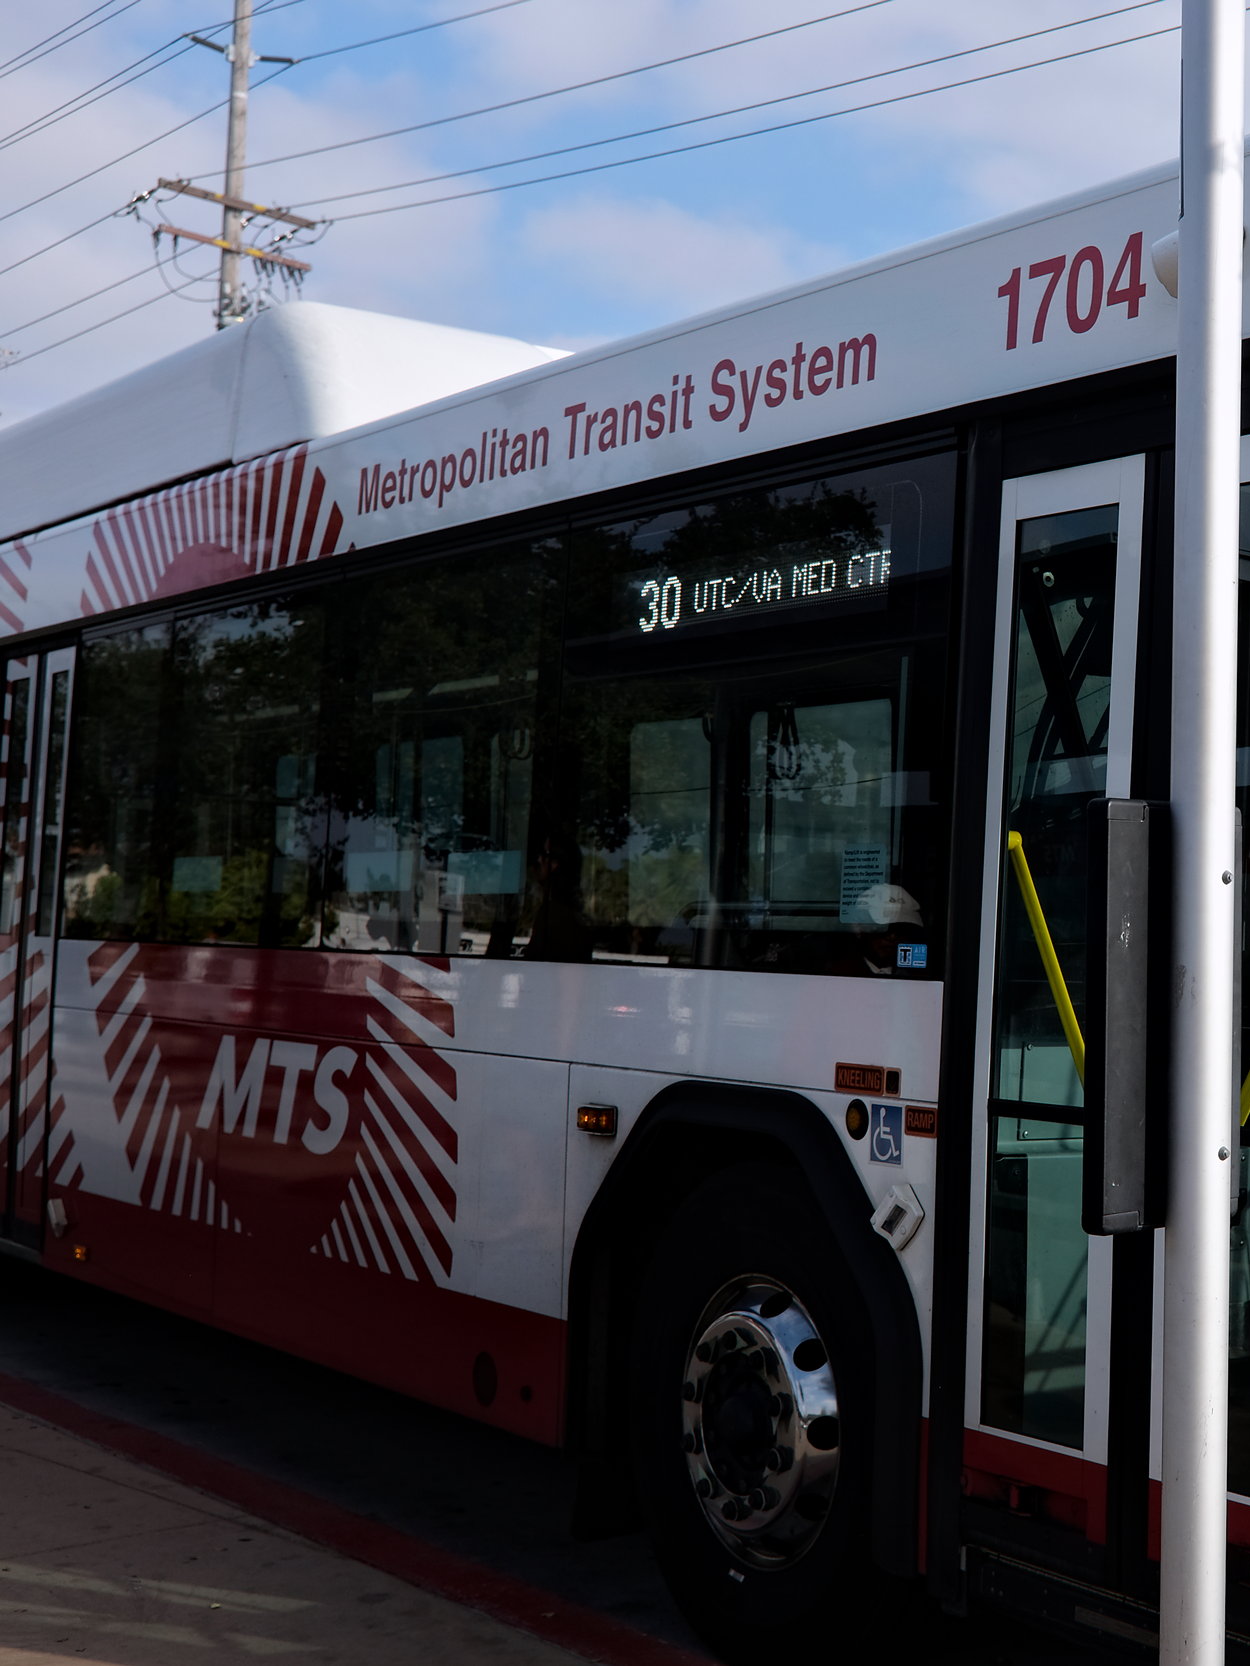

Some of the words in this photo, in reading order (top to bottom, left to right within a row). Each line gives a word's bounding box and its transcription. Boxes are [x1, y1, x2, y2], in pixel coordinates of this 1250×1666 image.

[998, 231, 1147, 351] 1704
[357, 426, 550, 516] Metropolitan
[564, 374, 696, 460] Transit
[708, 332, 878, 433] System
[639, 575, 682, 632] 30
[694, 569, 782, 613] UTC/VA
[791, 559, 837, 598] MED
[195, 1034, 359, 1155] MTS
[837, 1069, 881, 1090] KNEELING
[907, 1111, 934, 1130] RAMP
